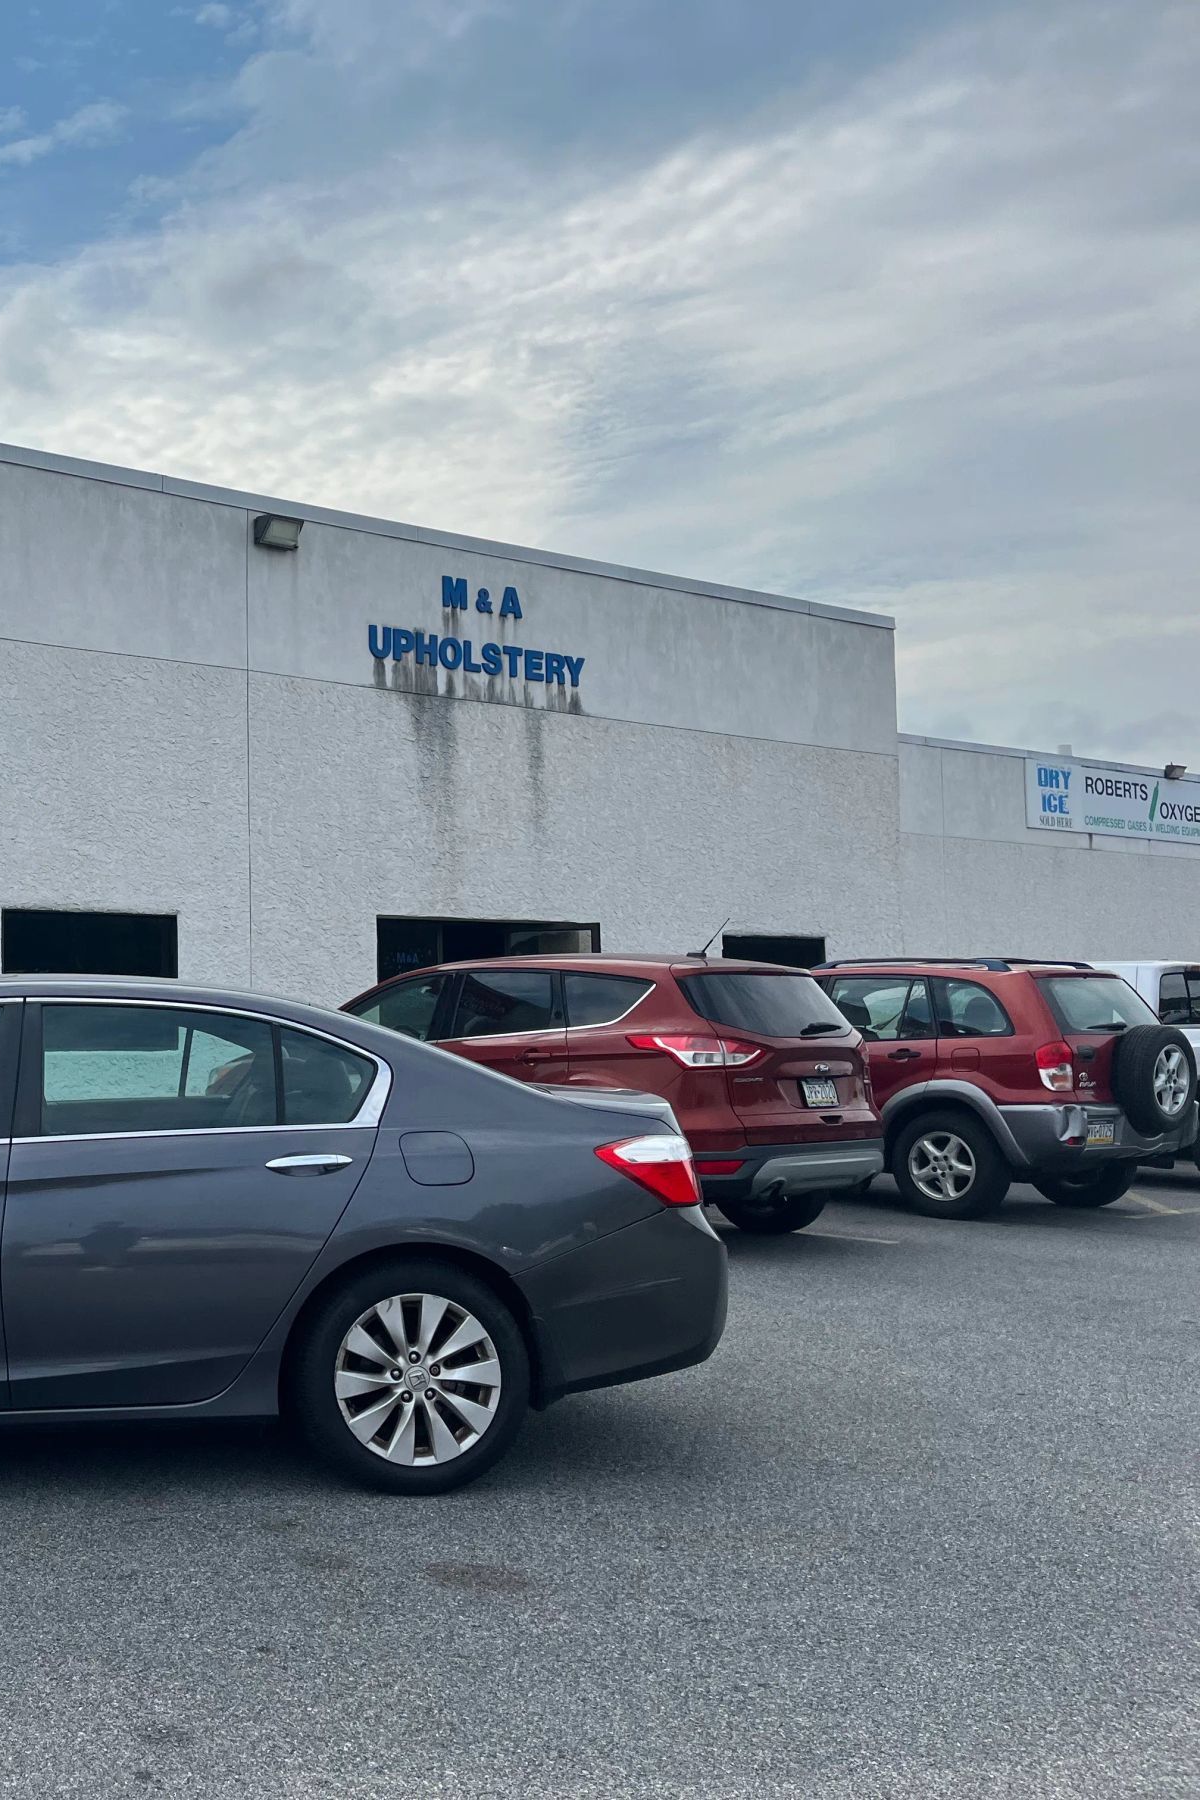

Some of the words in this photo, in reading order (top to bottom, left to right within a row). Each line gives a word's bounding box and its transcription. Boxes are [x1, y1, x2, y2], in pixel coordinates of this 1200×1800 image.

[441, 575, 468, 610] M
[476, 588, 493, 614] &
[499, 586, 523, 619] A
[368, 624, 586, 687] UPHOLSTERY
[1036, 766, 1072, 790] DRY
[1084, 776, 1148, 801] ROBERTS
[1041, 792, 1070, 815] ICE
[1084, 815, 1126, 830] COMPRESSED
[1127, 820, 1147, 832] GASES
[1155, 823, 1180, 835] WELDING
